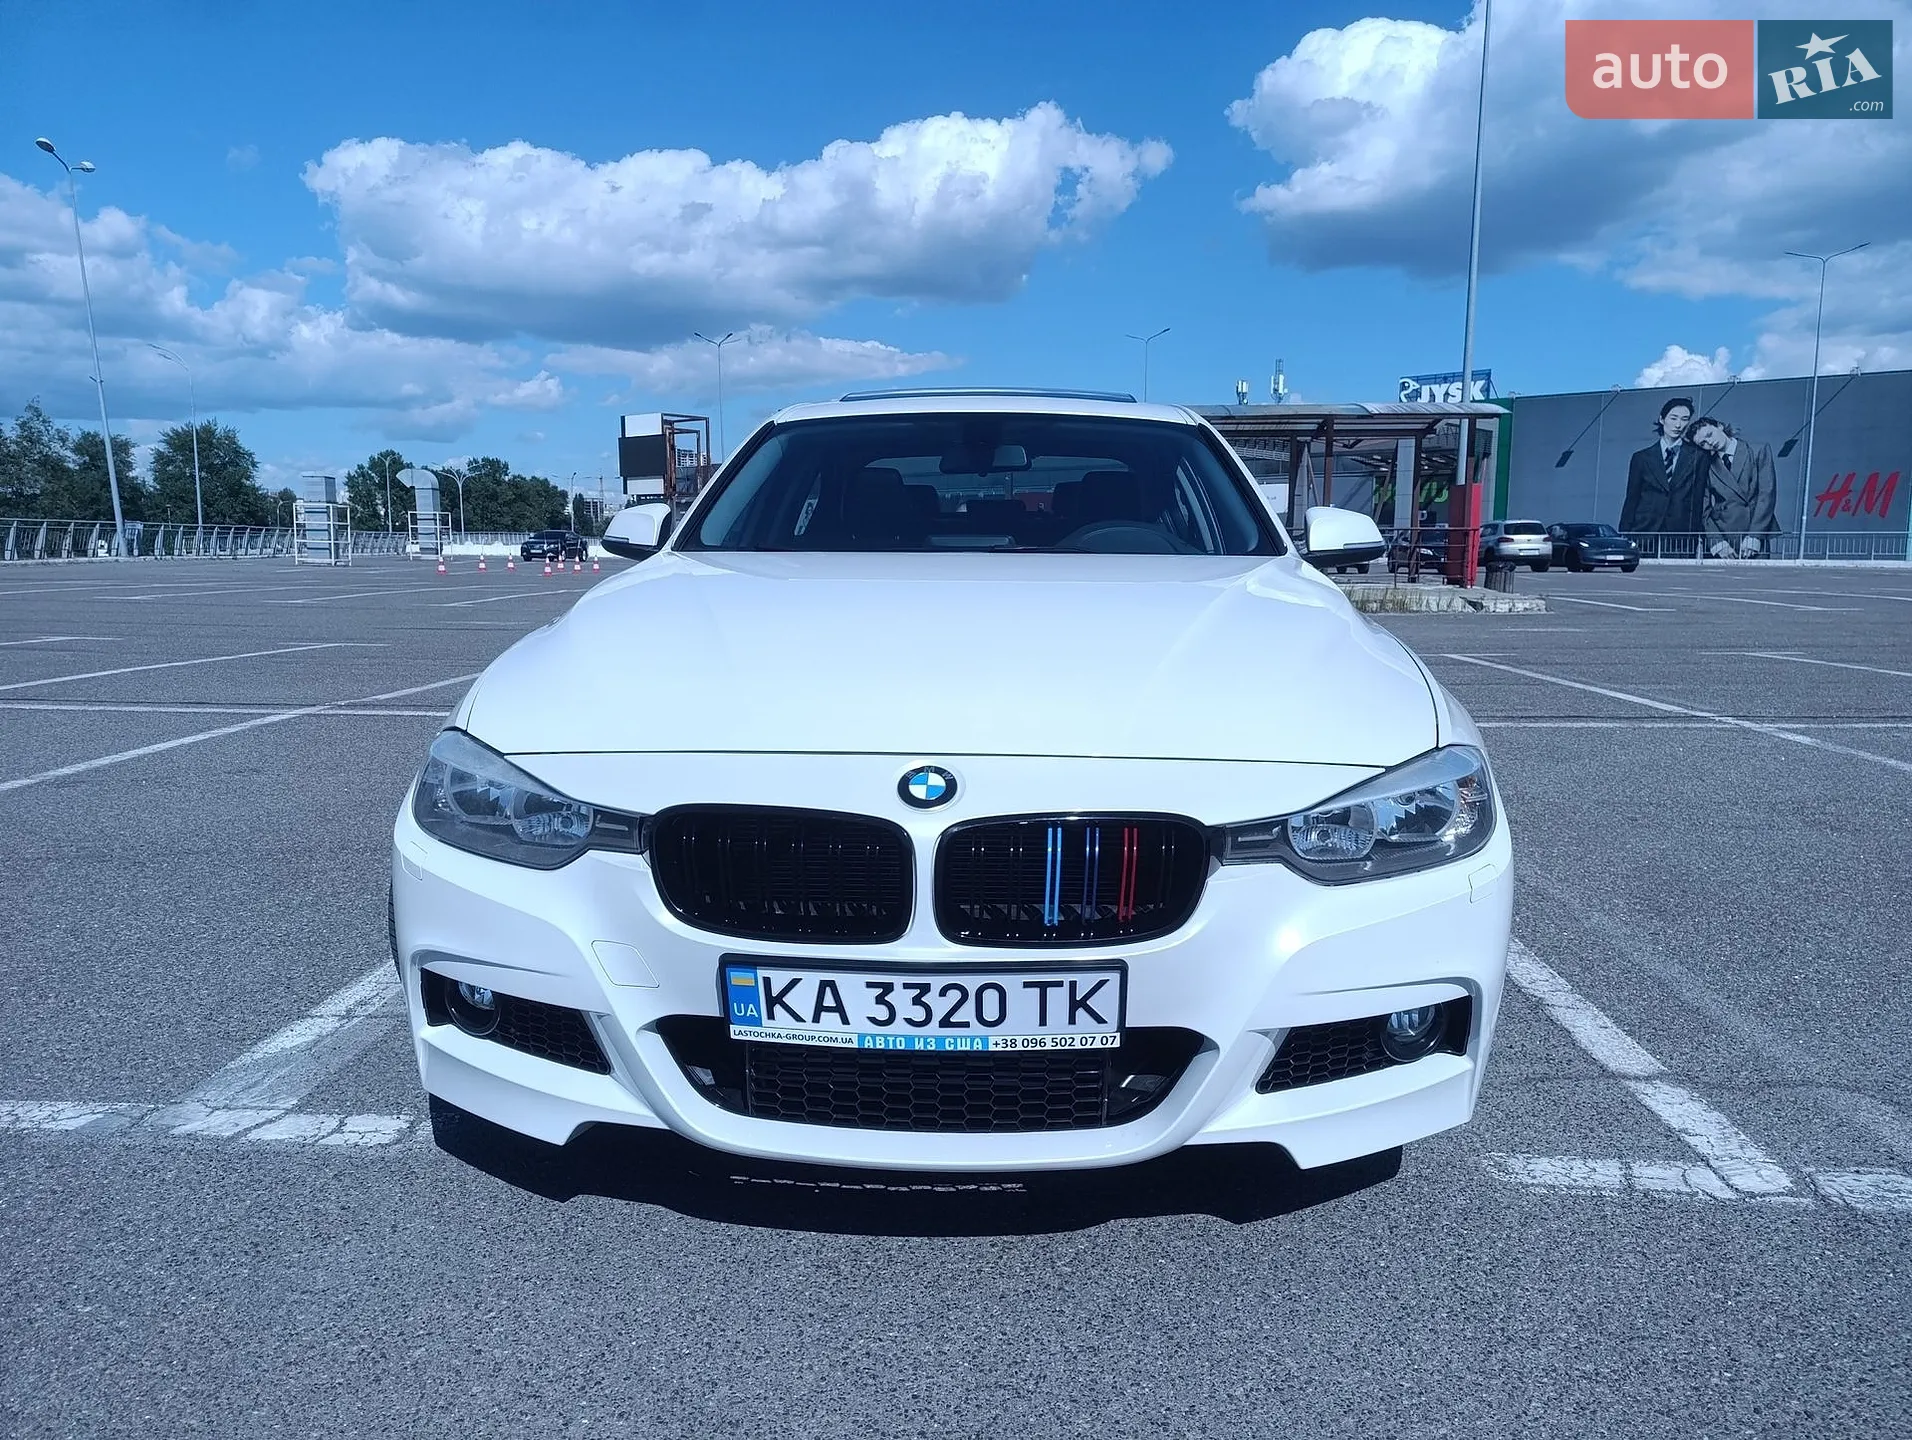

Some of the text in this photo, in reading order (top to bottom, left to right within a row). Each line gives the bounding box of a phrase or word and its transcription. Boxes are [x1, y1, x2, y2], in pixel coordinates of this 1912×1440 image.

[1417, 380, 1487, 404] JYSK
[1813, 471, 1901, 519] H&M
[905, 766, 955, 781] BMW
[733, 1002, 759, 1018] UA
[761, 976, 1111, 1029] KA 3320 TK
[732, 1028, 855, 1045] LASTOCHKA-GROUP.COM.UA
[863, 1036, 984, 1051] АВТО ИЗ США
[992, 1034, 1118, 1050] +38 096 502 07 07
